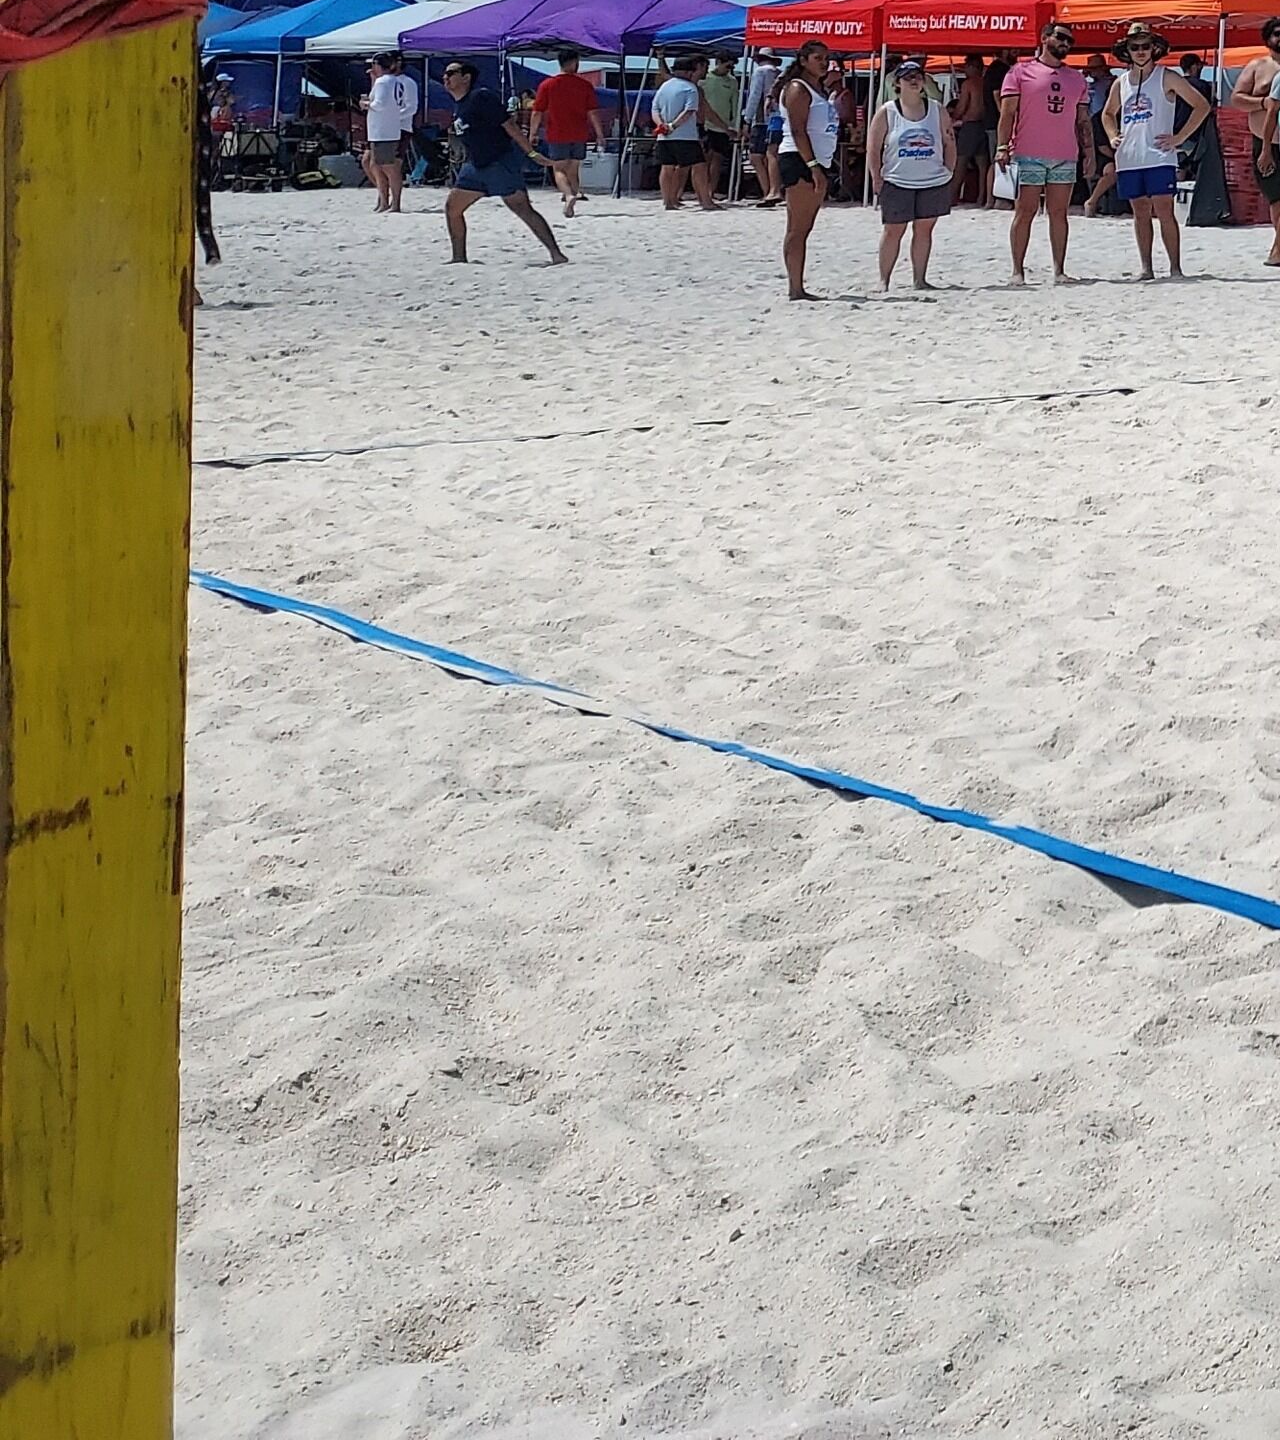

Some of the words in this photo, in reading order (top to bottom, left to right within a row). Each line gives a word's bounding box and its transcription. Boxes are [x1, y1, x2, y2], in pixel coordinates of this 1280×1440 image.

[752, 19, 783, 35] Nothing
[785, 20, 799, 33] but
[800, 20, 833, 34] HEAVY
[889, 15, 927, 32] Nothing
[929, 15, 946, 29] but
[948, 15, 988, 30] HEAVY
